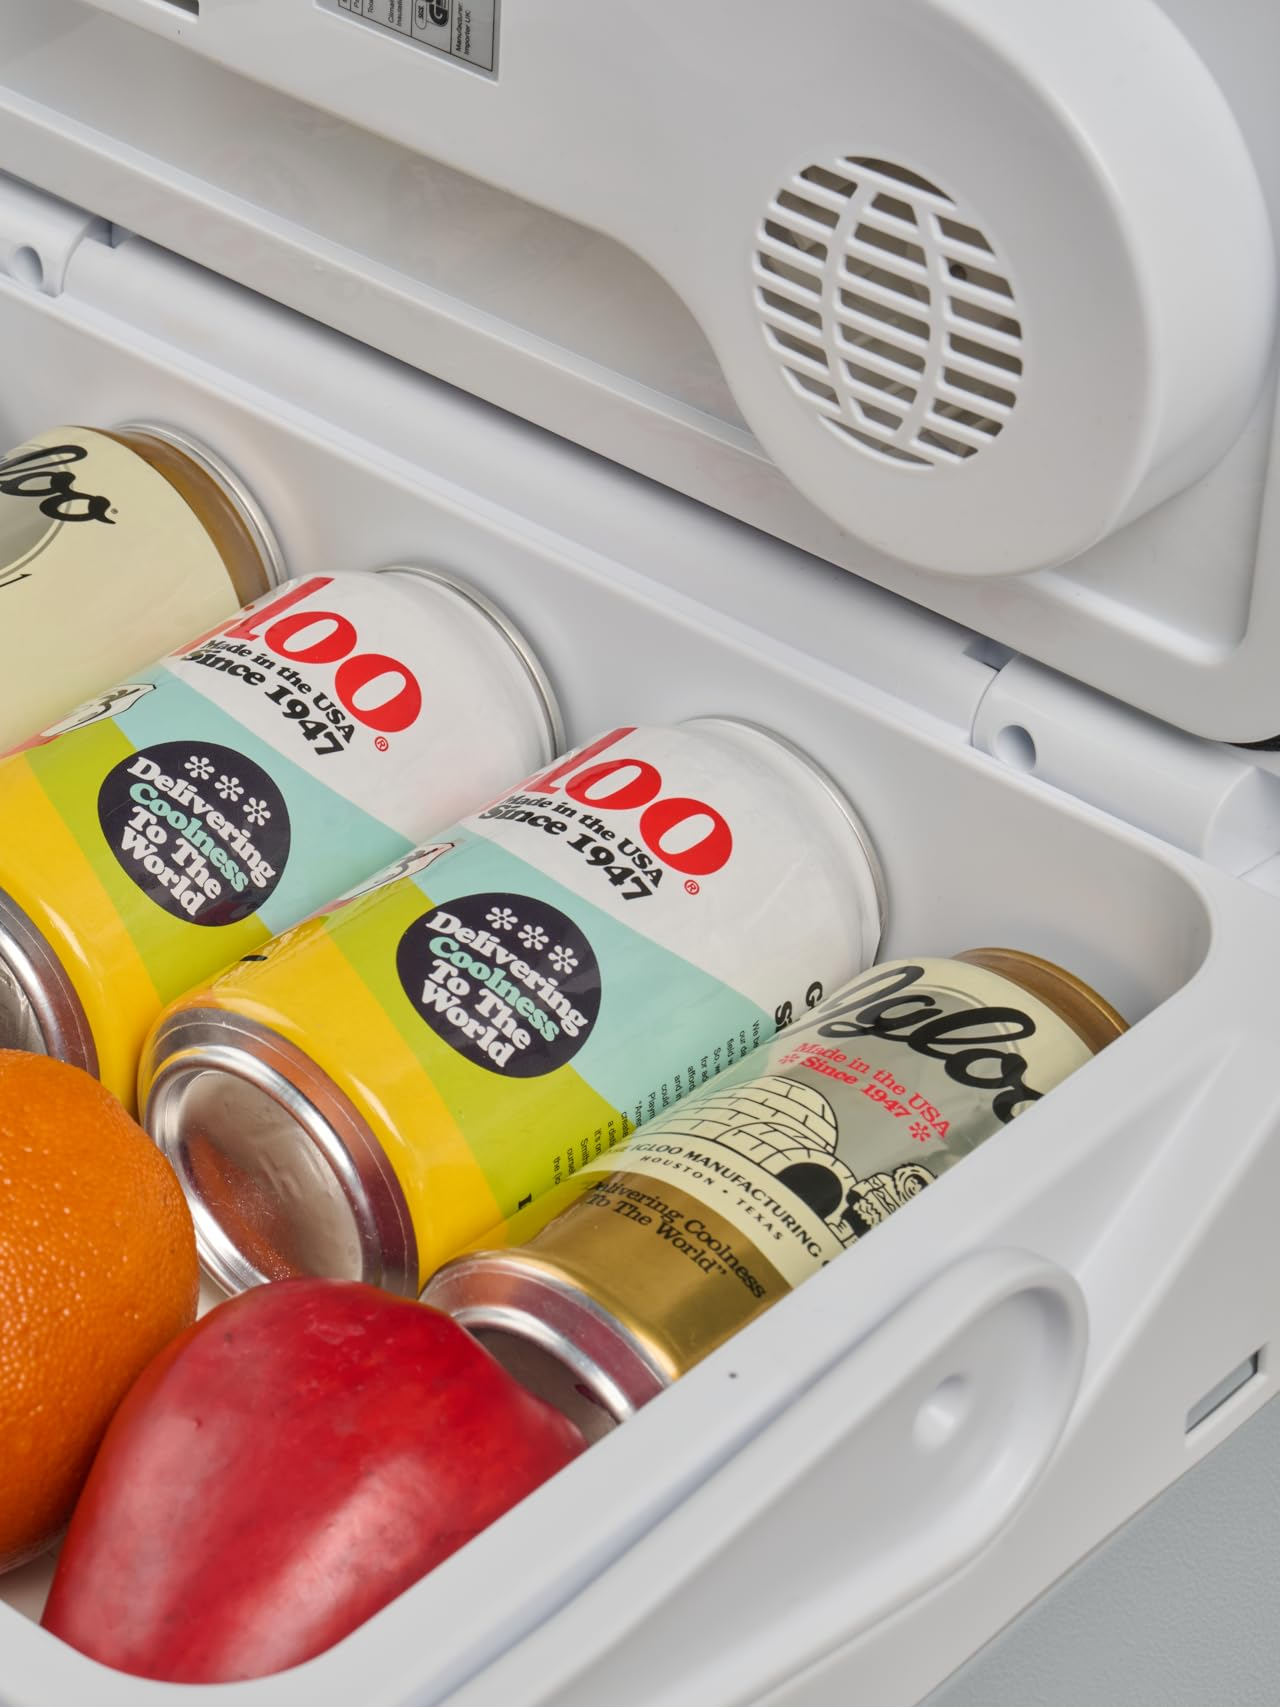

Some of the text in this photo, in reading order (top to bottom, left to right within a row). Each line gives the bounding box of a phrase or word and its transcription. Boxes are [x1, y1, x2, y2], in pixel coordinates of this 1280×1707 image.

[180, 650, 345, 756] Since 1947
[201, 639, 356, 745] Made in the USA
[126, 756, 277, 888] Delivering
[127, 805, 222, 899] To The
[129, 782, 250, 893] Coolness
[478, 804, 654, 901] Since 1947
[503, 793, 664, 889] Made in the USA
[120, 825, 208, 917] World
[425, 911, 589, 1038] Delivering
[428, 936, 560, 1042] Coolness
[428, 958, 532, 1050] To The
[421, 978, 516, 1068] World
[647, 1091, 656, 1120] Playm
[674, 1074, 683, 1092] and
[793, 1042, 950, 1139] Made in the USA
[799, 1055, 913, 1118] Since 1947
[612, 1199, 653, 1227] The
[640, 1155, 784, 1241] HOUSTON TEXAS
[682, 1150, 823, 1259] MANUFACTURING
[683, 1218, 768, 1299] Coolness
